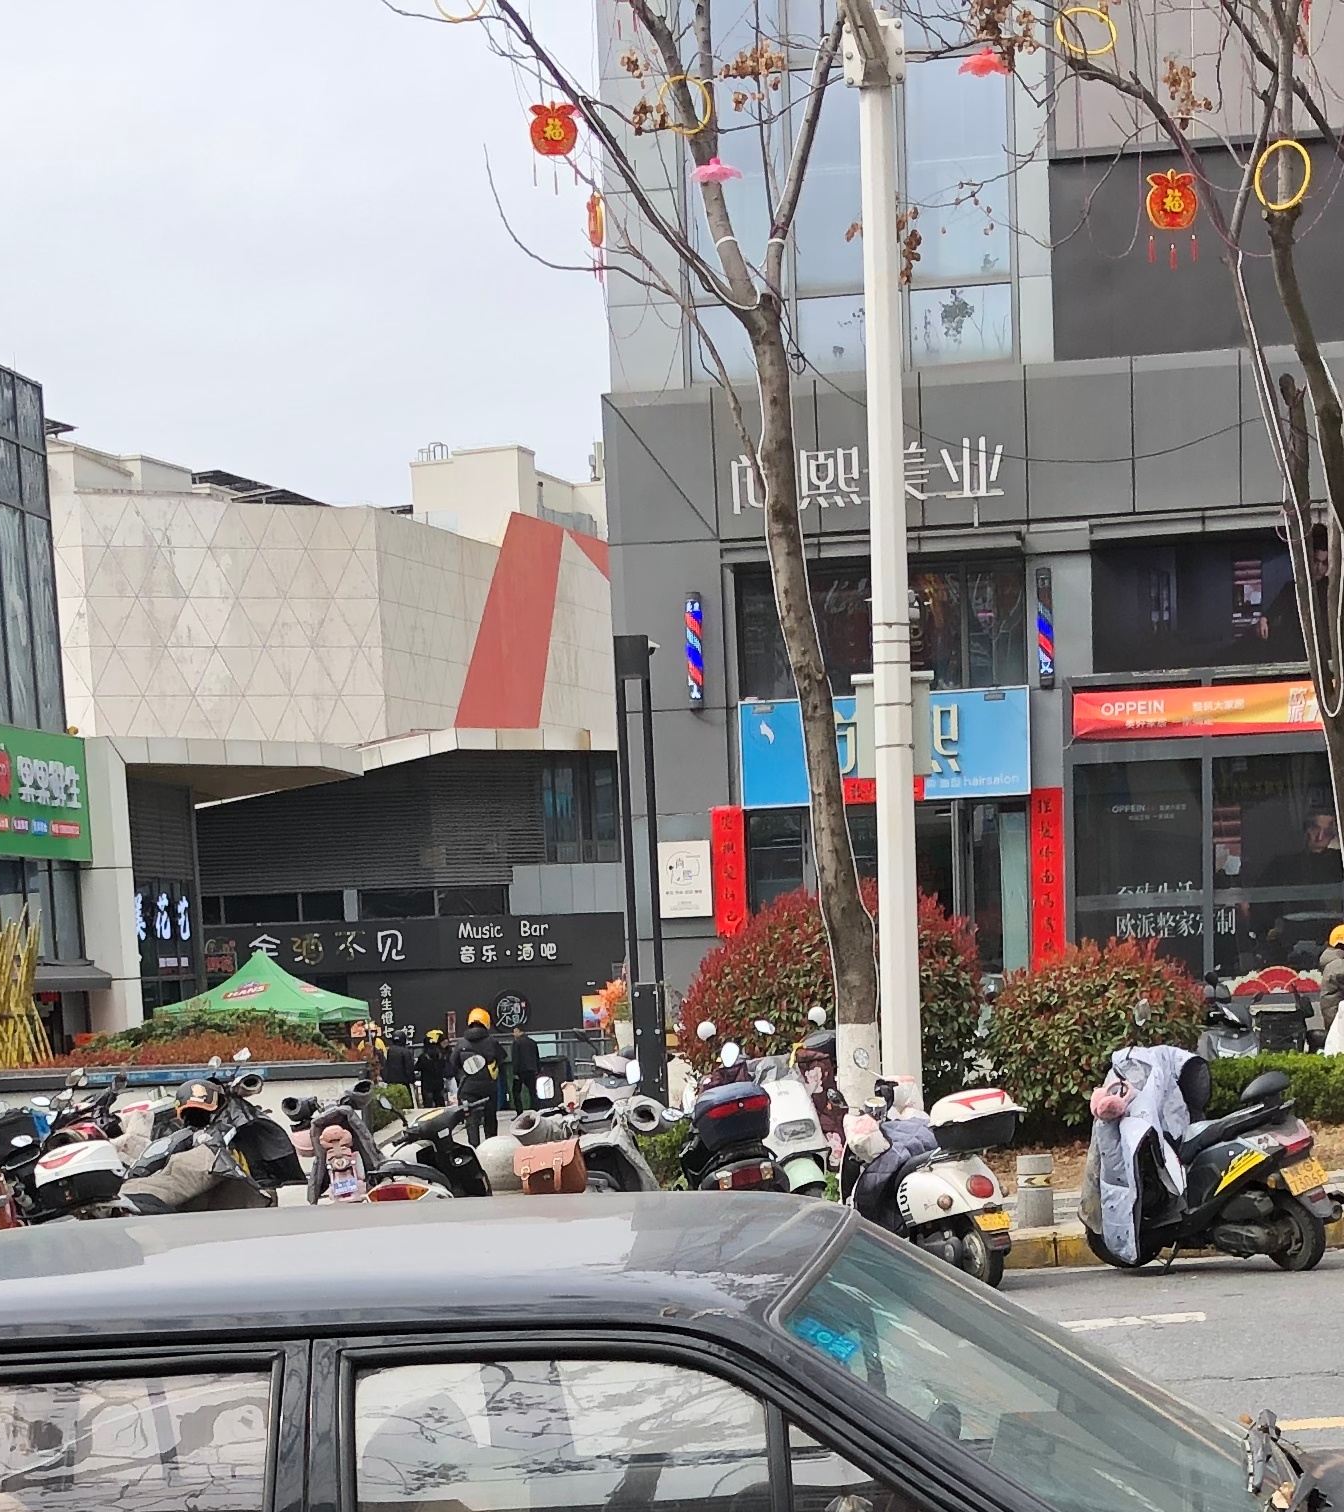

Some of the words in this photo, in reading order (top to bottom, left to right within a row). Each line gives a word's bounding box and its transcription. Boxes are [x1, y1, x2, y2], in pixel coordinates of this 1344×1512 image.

[543, 117, 565, 141] 福
[1163, 188, 1185, 213] 福
[1100, 699, 1165, 717] OPPEIN
[458, 921, 504, 939] Music
[520, 920, 549, 937] Bar
